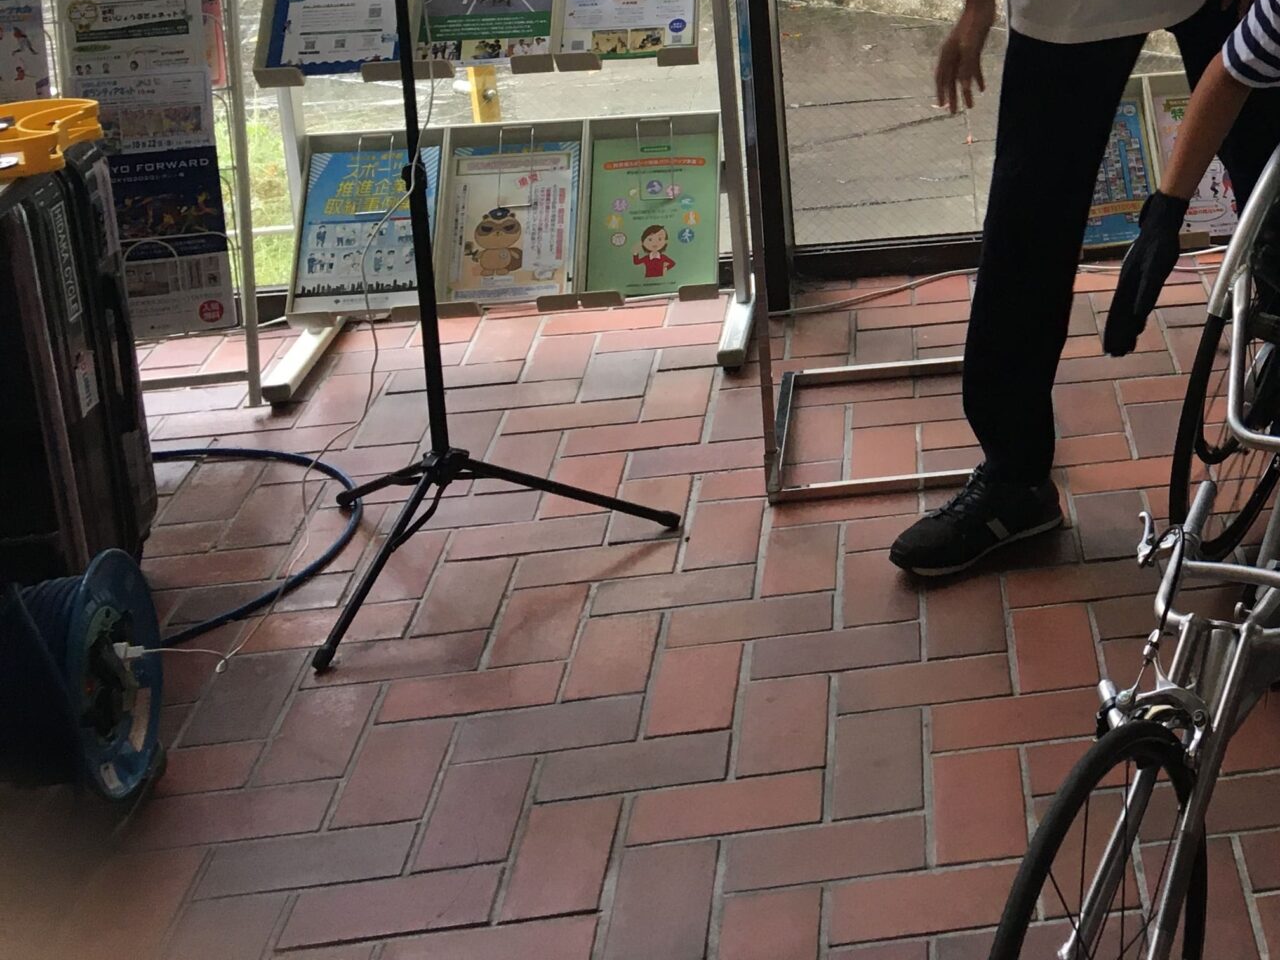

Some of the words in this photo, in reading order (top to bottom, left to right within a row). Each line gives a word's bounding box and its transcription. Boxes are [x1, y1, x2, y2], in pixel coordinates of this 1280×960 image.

[135, 157, 210, 173] FORWARD
[343, 162, 405, 179] スポーツ
[335, 179, 407, 197] 推進企業
[54, 207, 69, 263] HIDAKA
[63, 264, 80, 313] CYCLE
